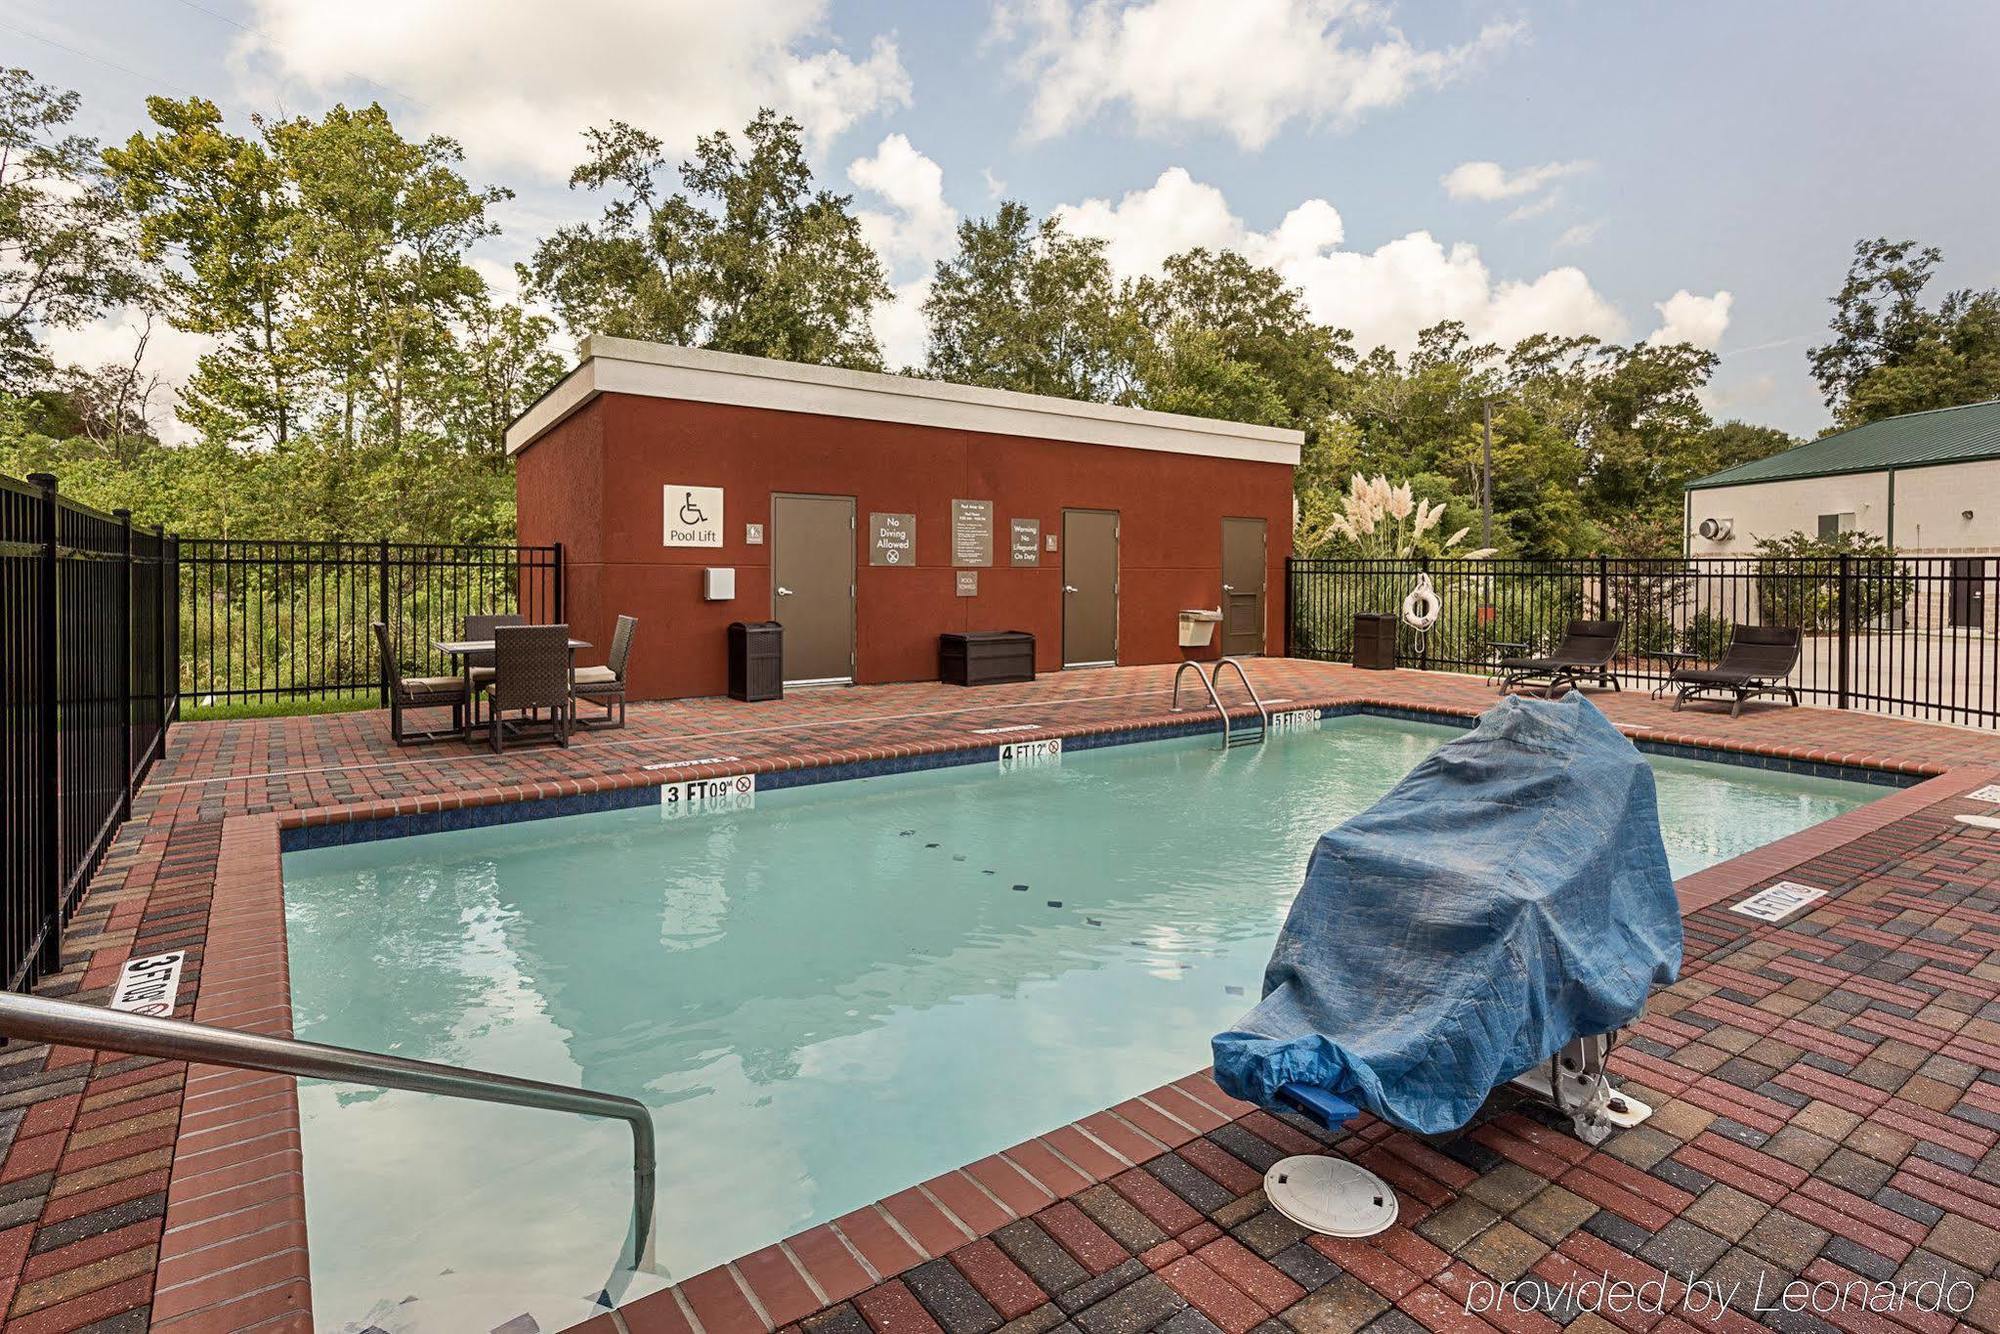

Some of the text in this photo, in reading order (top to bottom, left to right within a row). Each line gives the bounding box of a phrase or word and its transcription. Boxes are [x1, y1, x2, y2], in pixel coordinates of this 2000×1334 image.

[887, 518, 899, 526] No
[671, 530, 716, 542] Pool Lift
[880, 528, 906, 540] Diving
[1014, 525, 1036, 535] Warning
[876, 539, 909, 549] Allowed
[1024, 553, 1036, 562] Duty
[1275, 715, 1281, 726] 5
[1284, 713, 1293, 724] FT
[1002, 746, 1012, 760] 4
[1016, 745, 1029, 758] FT
[668, 786, 679, 802] 3
[687, 781, 708, 801] FT
[1752, 897, 1792, 911] FT
[1743, 905, 1777, 916] 4
[128, 955, 180, 971] 3
[126, 967, 173, 988] FT
